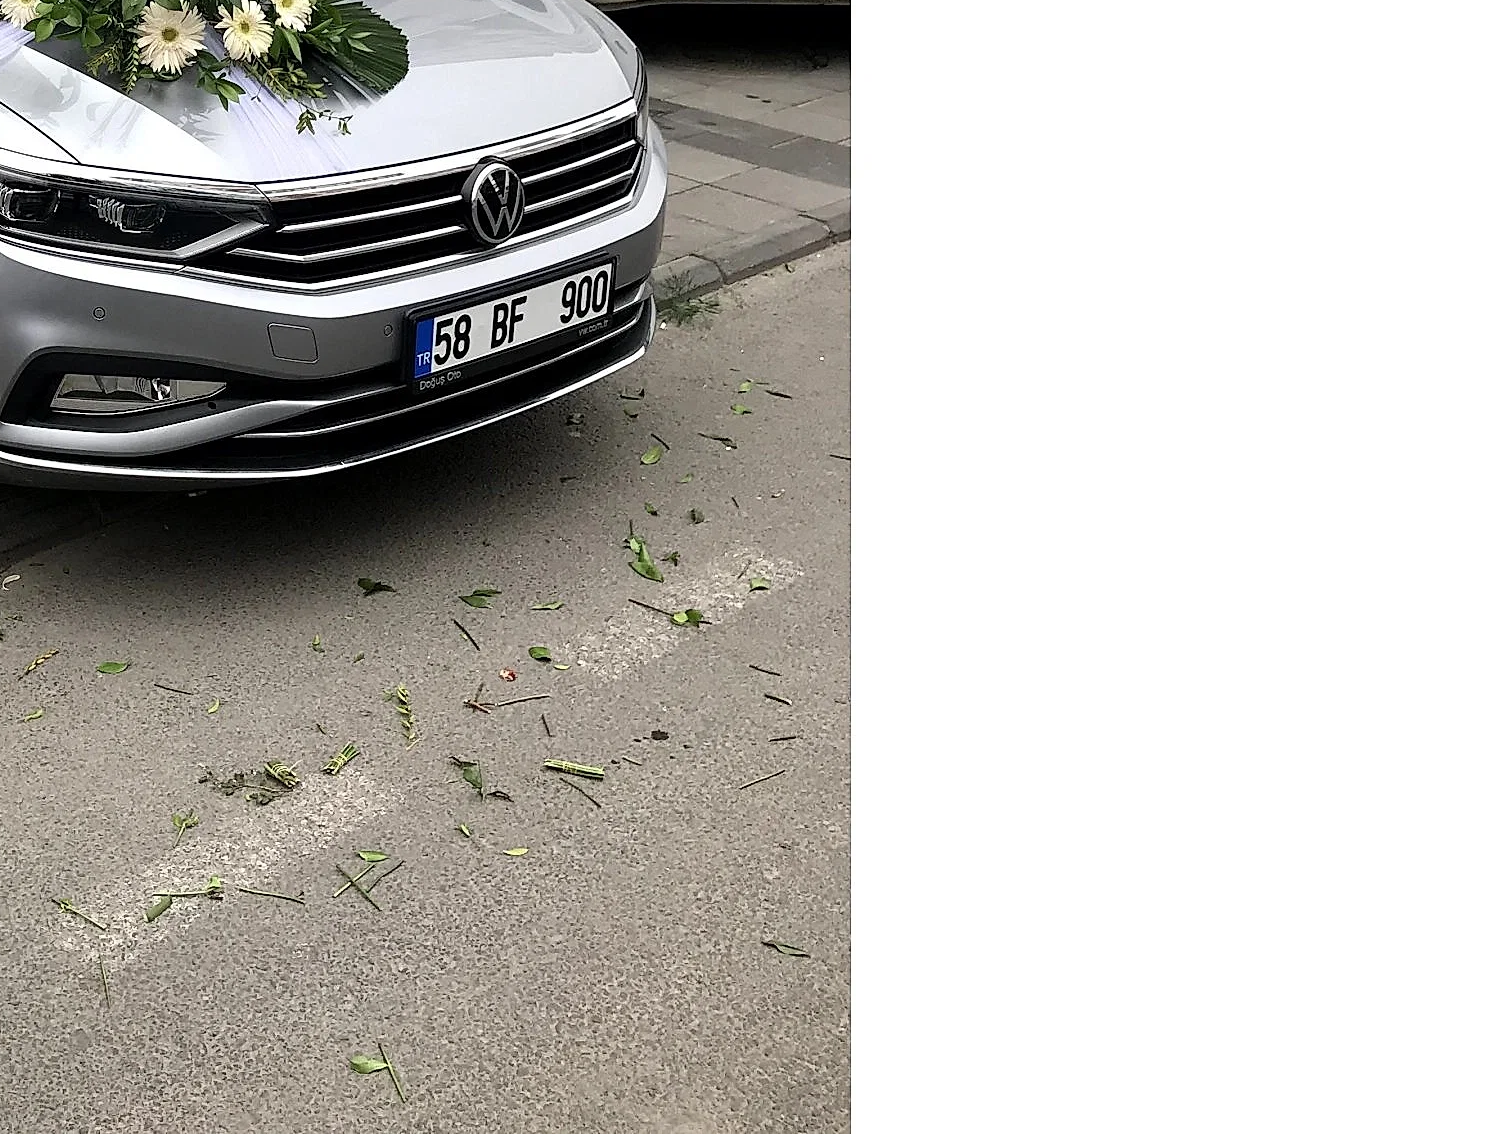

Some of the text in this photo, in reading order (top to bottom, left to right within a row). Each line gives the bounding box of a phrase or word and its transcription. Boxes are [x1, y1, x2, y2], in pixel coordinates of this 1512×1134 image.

[434, 270, 609, 366] 58 BF 900
[416, 351, 431, 367] TR
[419, 370, 462, 391] Doğuş Oto
